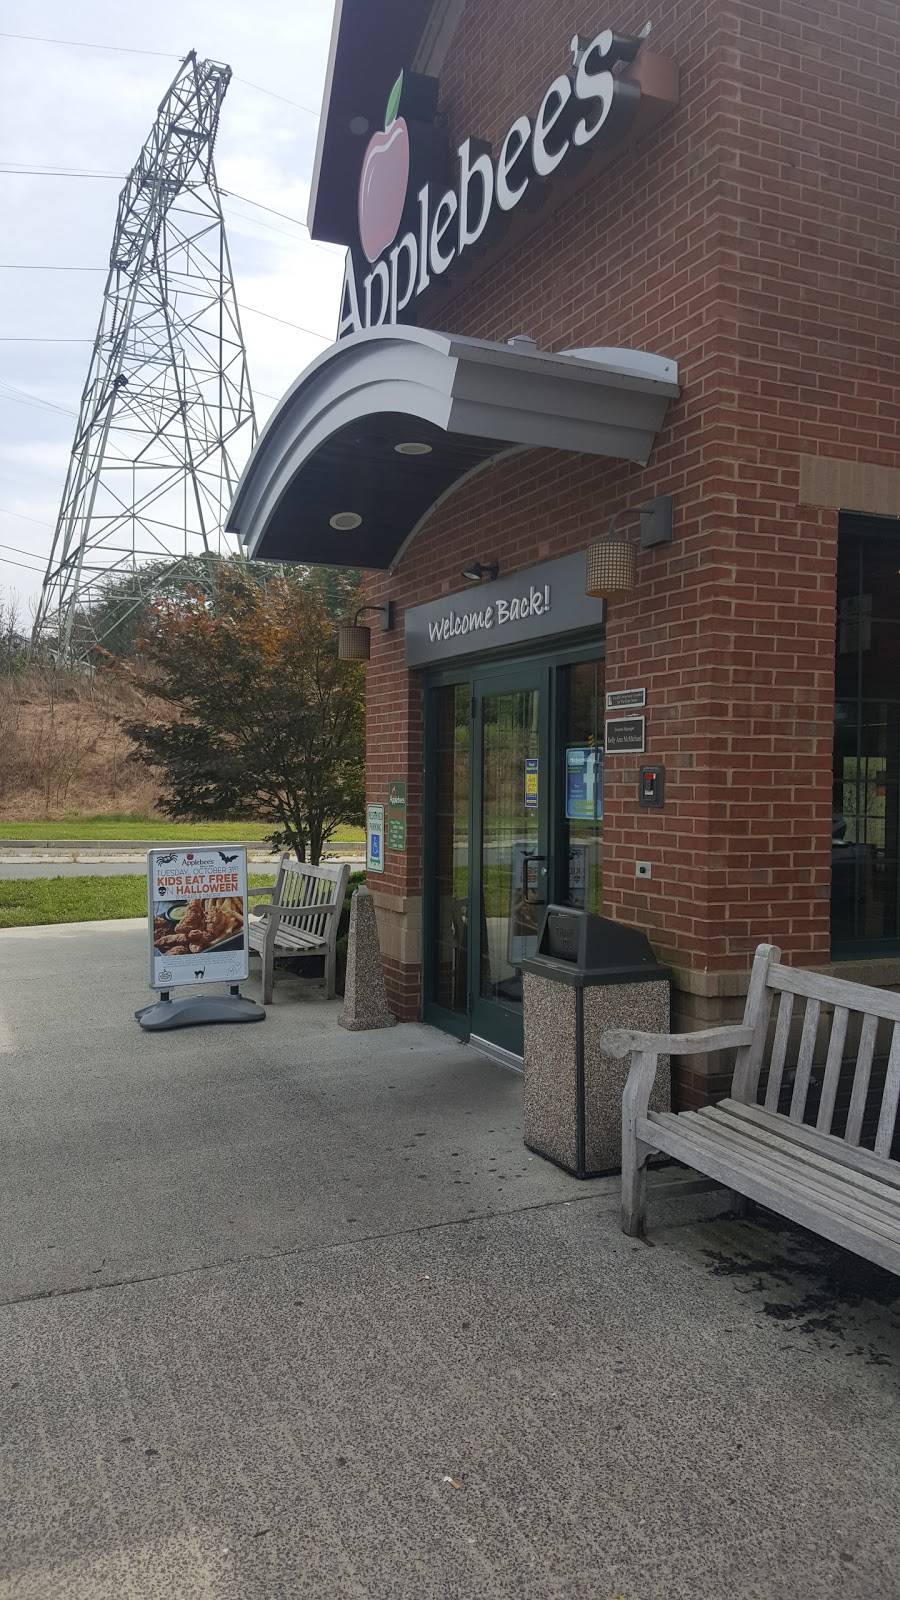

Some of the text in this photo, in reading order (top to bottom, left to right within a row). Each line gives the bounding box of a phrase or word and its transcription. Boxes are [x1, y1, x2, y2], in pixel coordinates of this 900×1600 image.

[337, 28, 614, 341] Applebee's
[428, 585, 550, 642] Welcome Back!
[181, 858, 215, 867] Applebee's
[193, 867, 226, 875] OCTOBER
[157, 873, 239, 886] KIDS EAT FREE
[176, 883, 238, 895] HALLOWEEN
